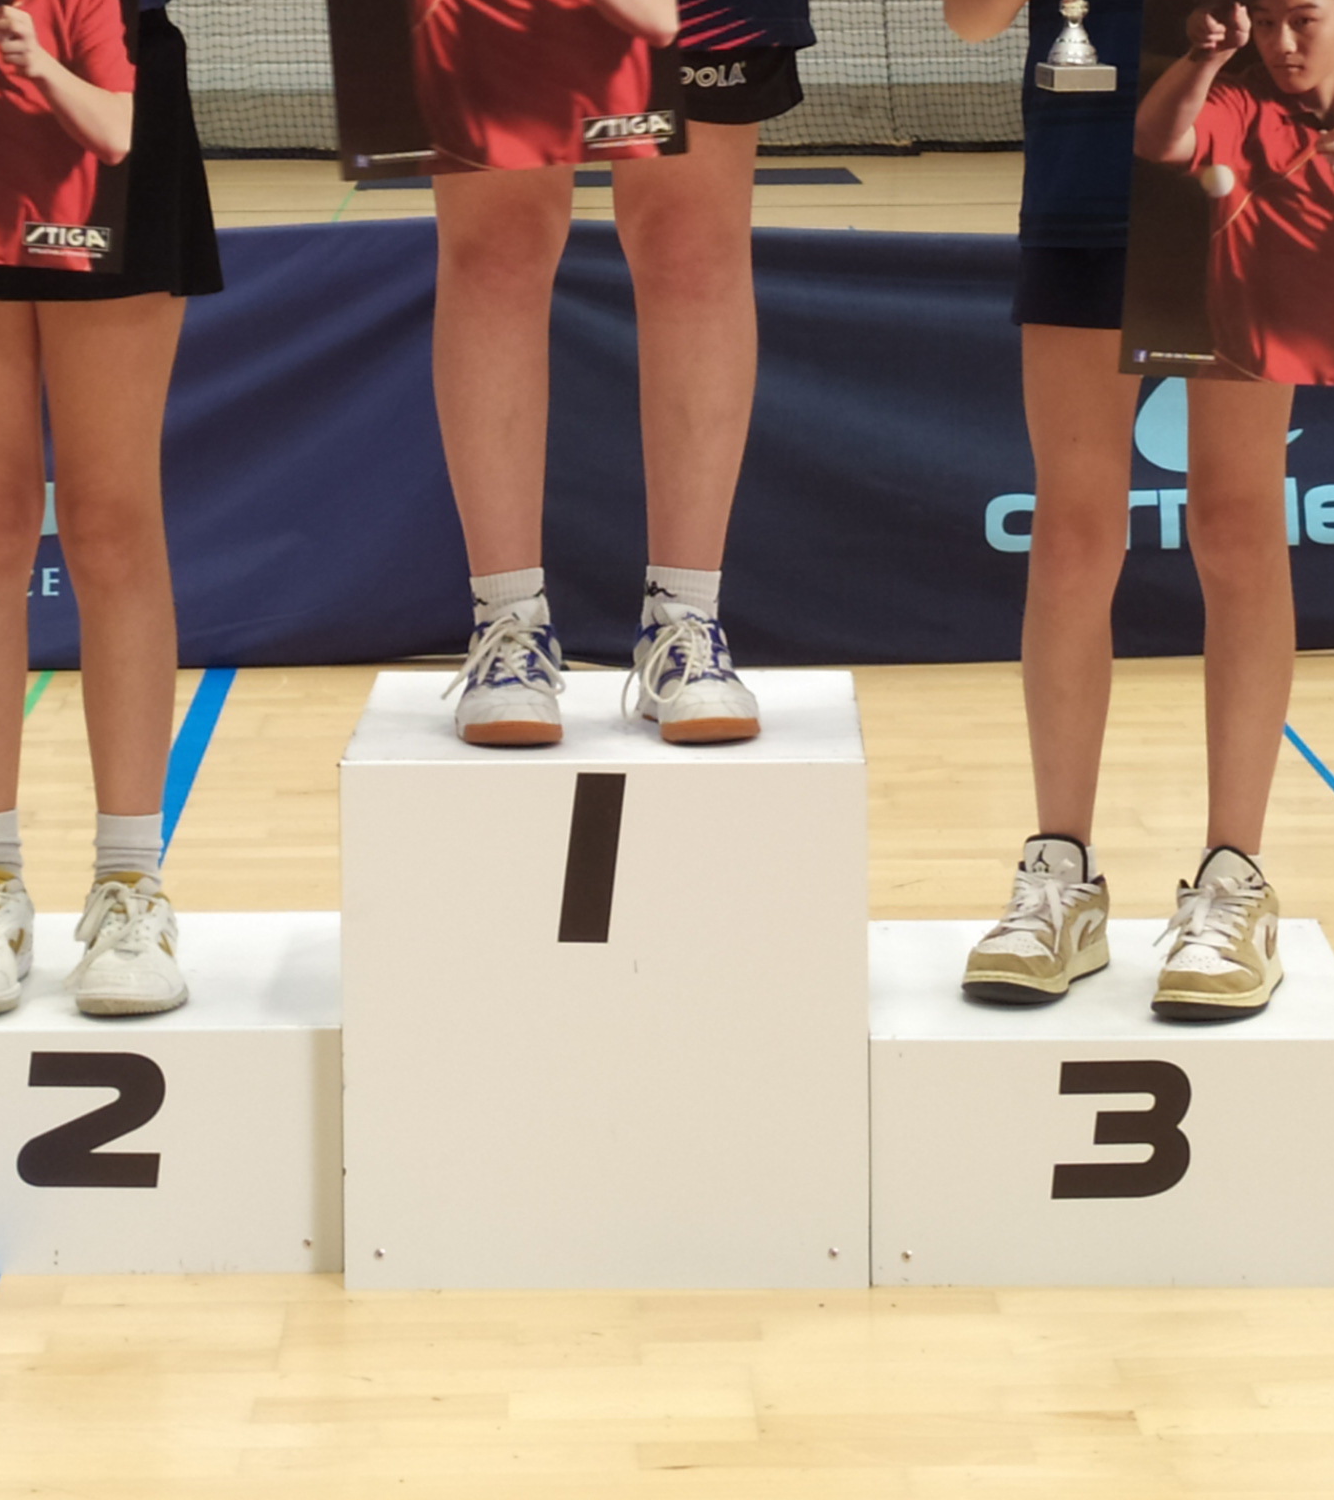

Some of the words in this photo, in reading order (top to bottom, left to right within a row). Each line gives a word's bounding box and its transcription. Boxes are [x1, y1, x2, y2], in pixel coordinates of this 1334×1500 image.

[584, 114, 672, 139] STIGA
[26, 227, 107, 248] STIGA
[557, 772, 627, 945] 1
[16, 1052, 166, 1189] 2
[1049, 1060, 1192, 1201] 3
